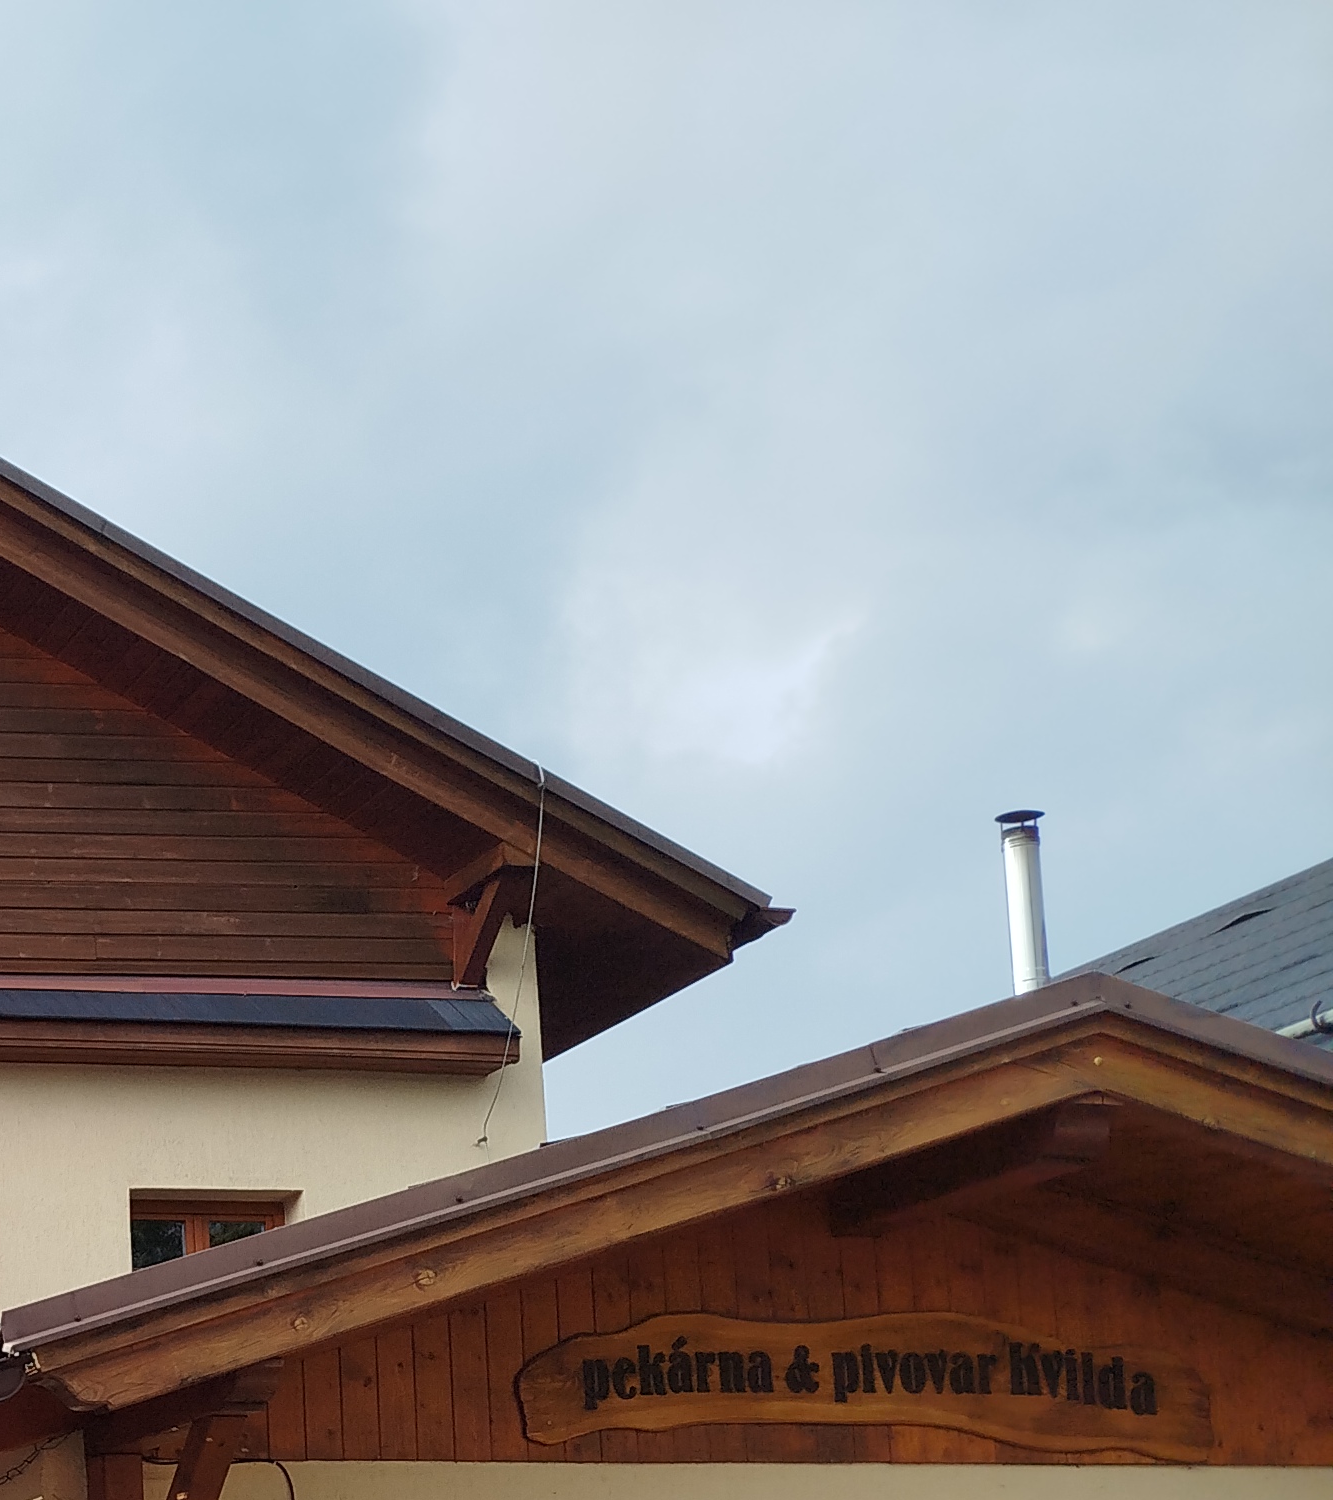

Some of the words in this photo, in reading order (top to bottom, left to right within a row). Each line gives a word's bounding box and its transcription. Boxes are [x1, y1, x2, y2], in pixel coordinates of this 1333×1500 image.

[582, 1335, 775, 1410] pekárna
[784, 1343, 821, 1394] &
[831, 1342, 998, 1404] pivovar
